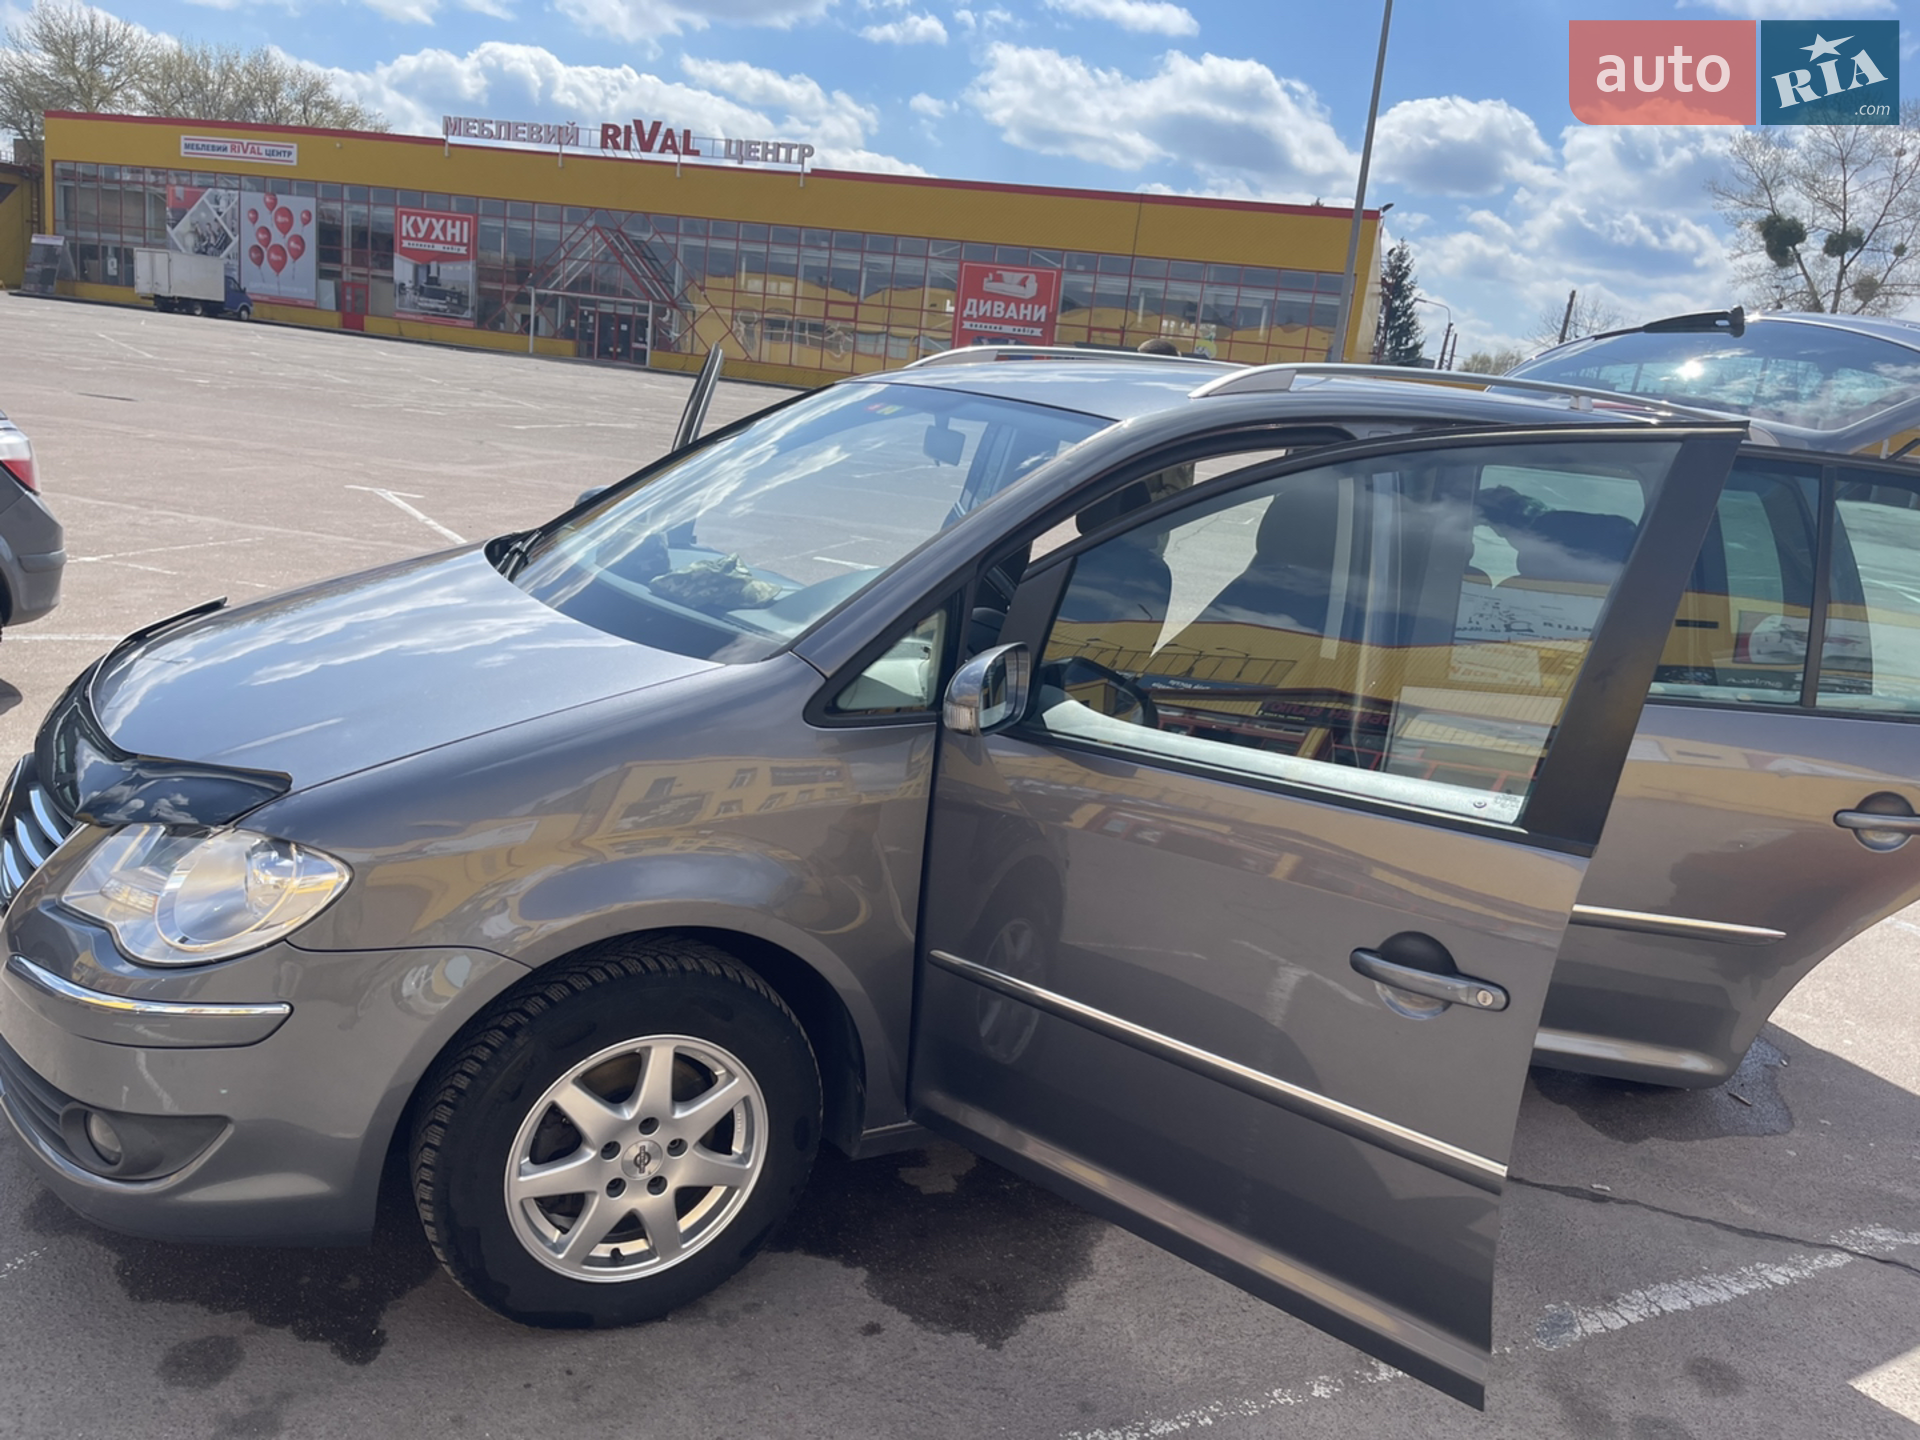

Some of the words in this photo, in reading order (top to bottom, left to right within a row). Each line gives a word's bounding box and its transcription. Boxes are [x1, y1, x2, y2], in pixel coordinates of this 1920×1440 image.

[184, 142, 228, 153] МЕБЛЕВИЙ
[265, 148, 293, 158] ЦЕНТР
[442, 116, 579, 147] МЕБЛЕВИЙ
[724, 138, 815, 165] ЦЕНТР
[401, 214, 469, 243] КУХНІ
[963, 298, 1047, 323] ДИВАНИ
